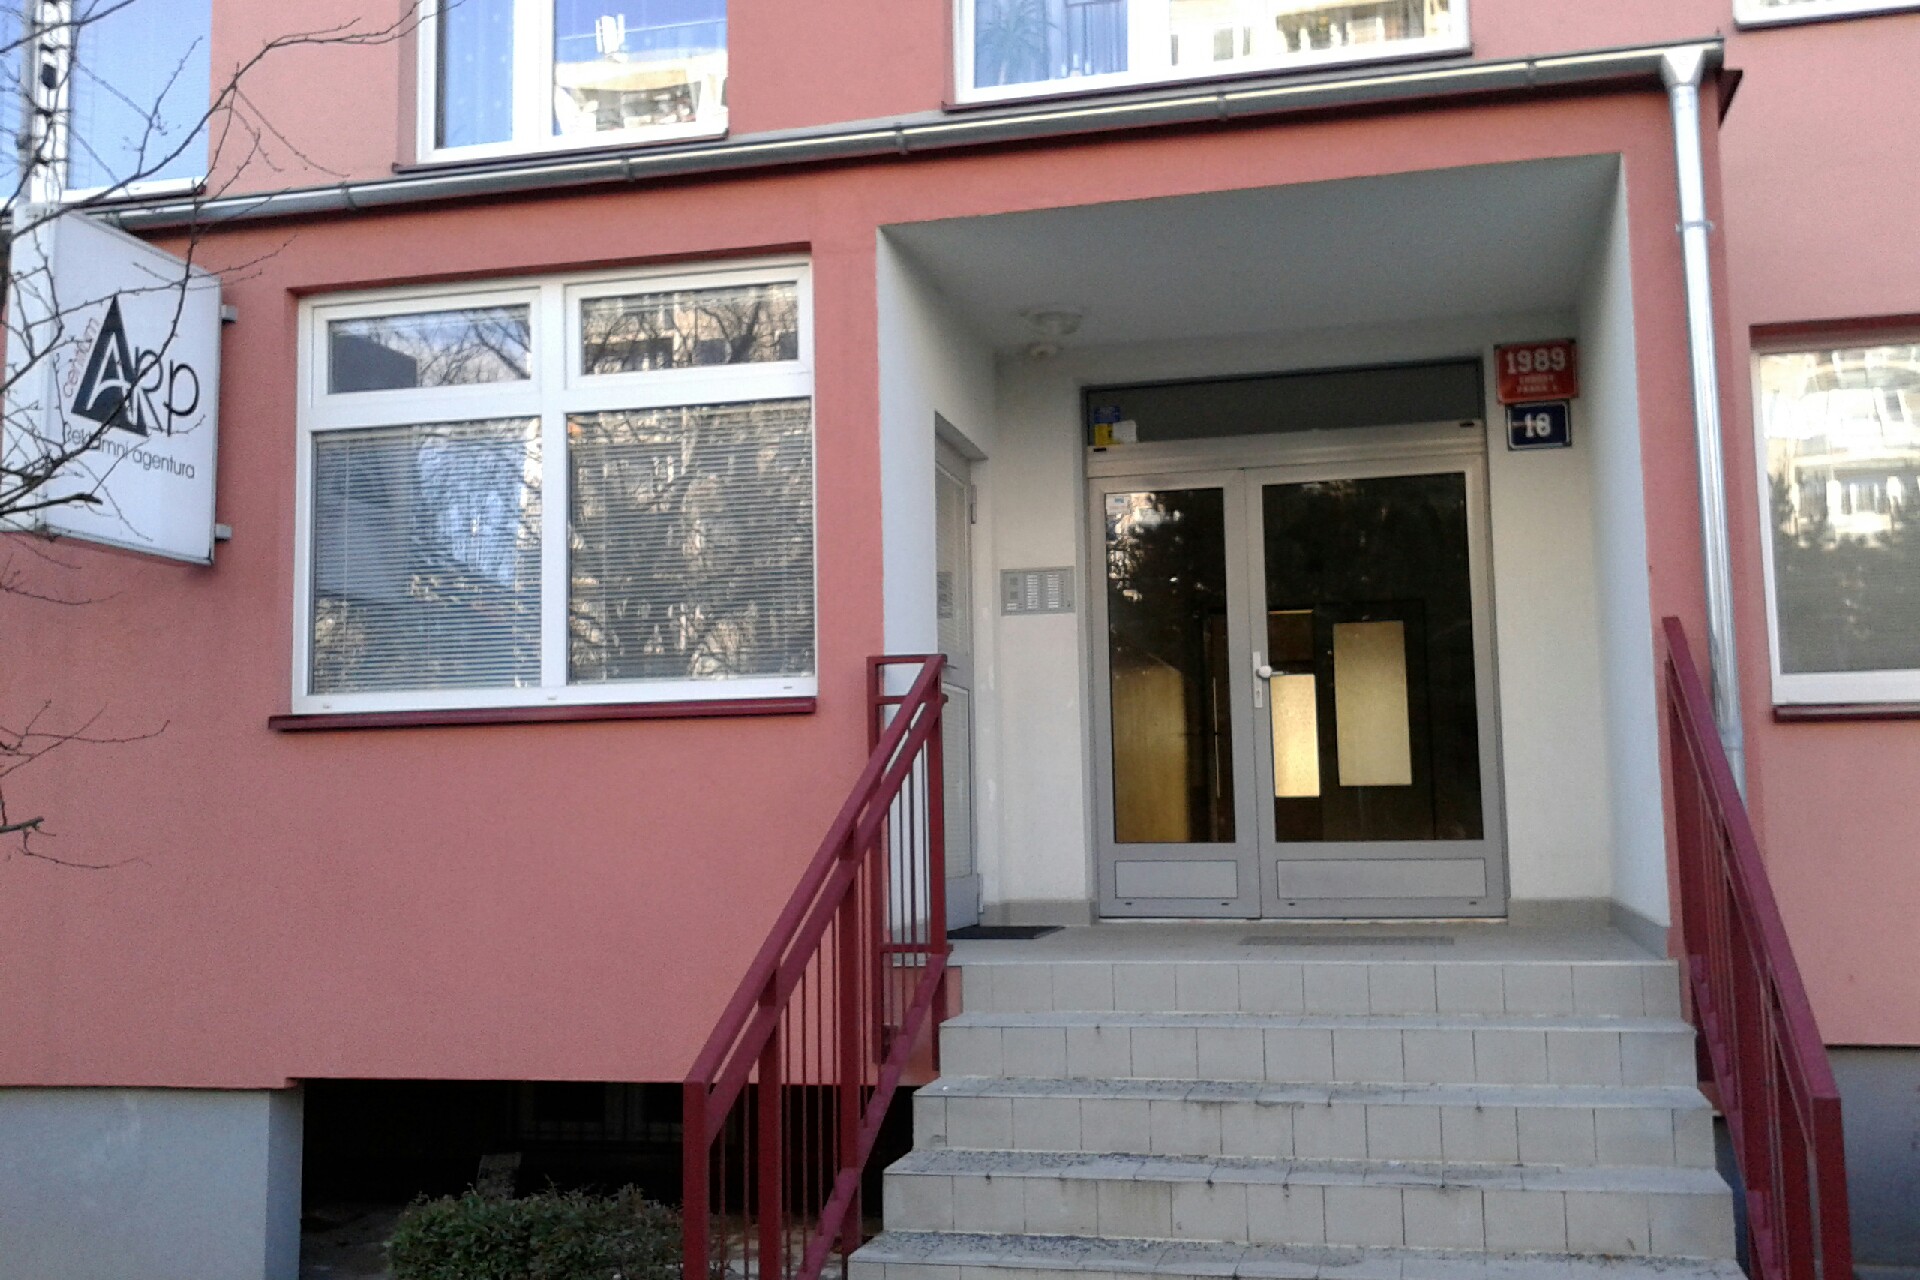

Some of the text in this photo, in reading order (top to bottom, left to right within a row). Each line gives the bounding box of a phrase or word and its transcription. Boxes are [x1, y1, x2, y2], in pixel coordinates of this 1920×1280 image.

[1506, 347, 1566, 375] 1989
[1524, 412, 1551, 438] 18
[132, 448, 195, 479] agentura
